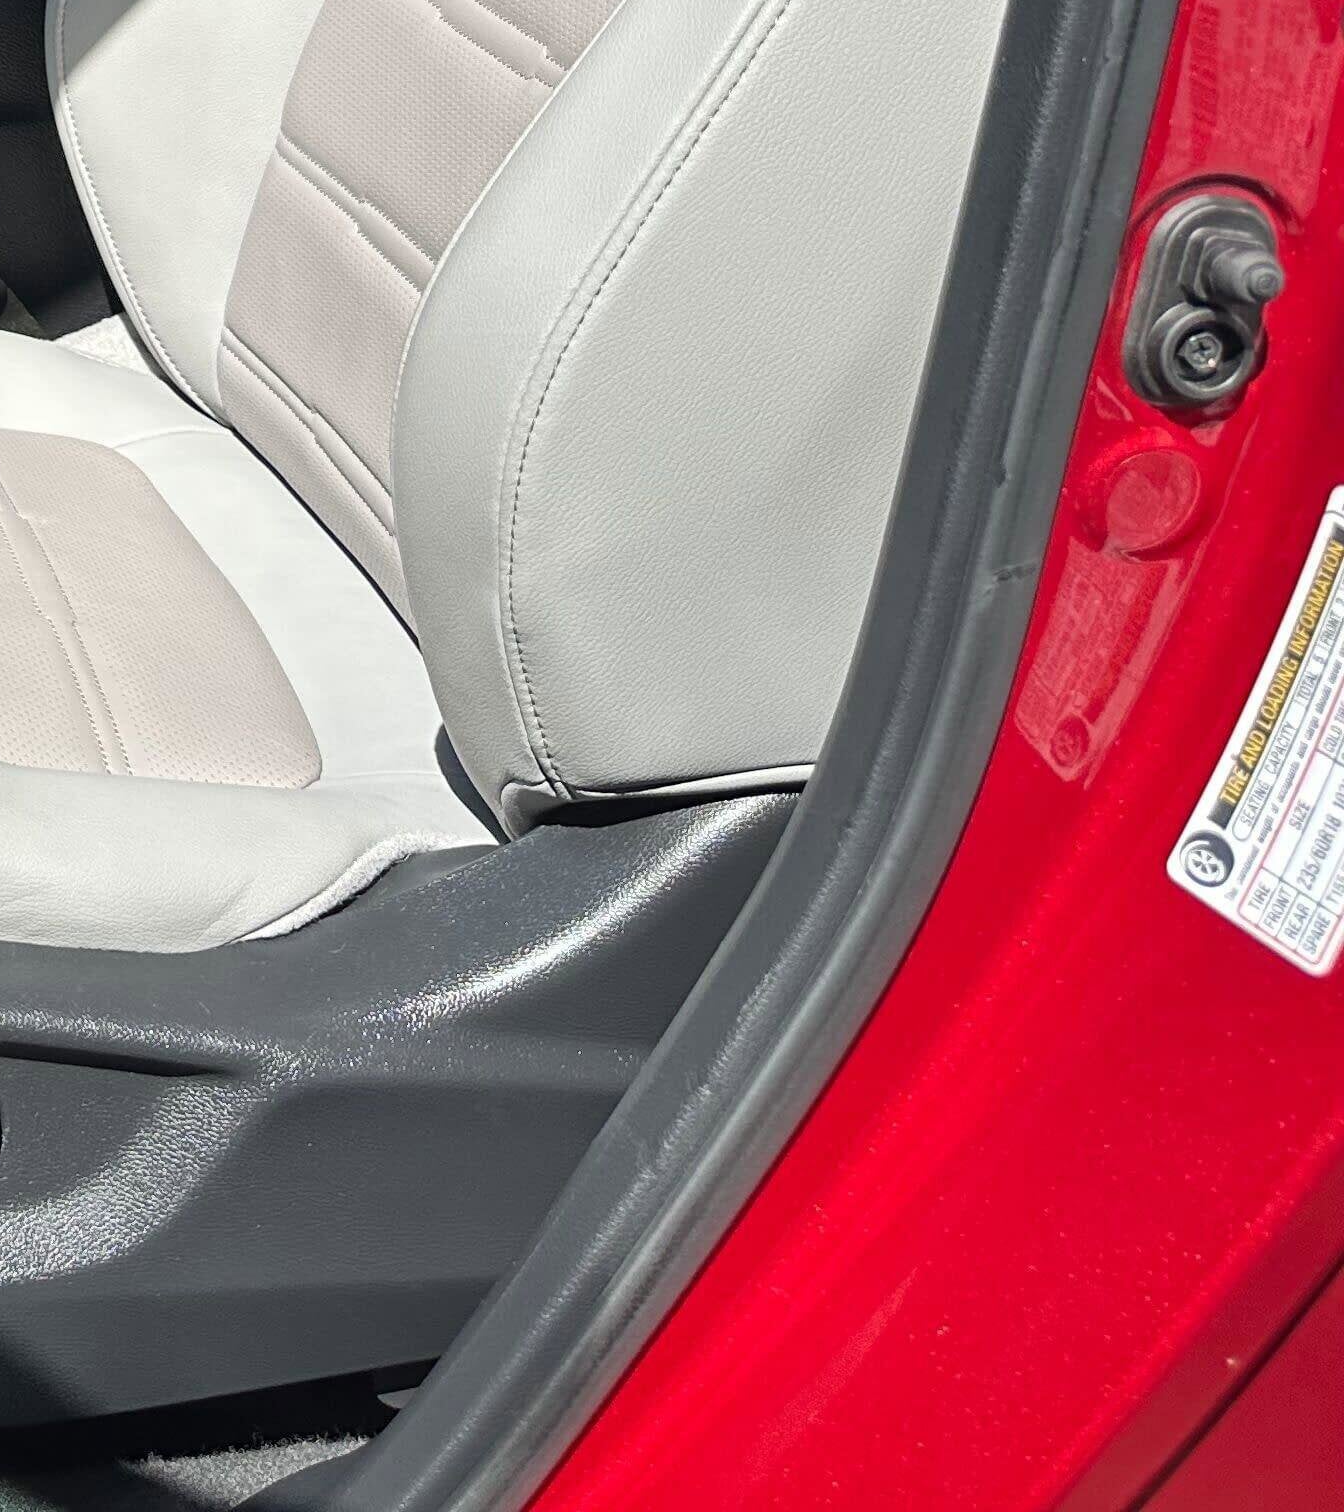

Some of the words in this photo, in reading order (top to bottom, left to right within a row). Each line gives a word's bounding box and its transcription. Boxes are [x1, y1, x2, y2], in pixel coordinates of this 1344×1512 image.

[1320, 613, 1341, 645] FRONT
[1221, 769, 1249, 805] TIRE
[1239, 731, 1263, 768] AND
[1257, 657, 1298, 727] LOADING
[1289, 541, 1344, 656] INFORMATION
[1297, 670, 1318, 702] TOTAL
[1322, 722, 1342, 755] COLD
[1243, 782, 1269, 828] SEATING
[1265, 721, 1296, 774] CAPACITY
[1289, 798, 1310, 831] SIZE
[1297, 814, 1342, 891] 235/60R18
[1248, 883, 1271, 911] TIRE
[1263, 886, 1293, 930] FRONT
[1285, 903, 1310, 941] REAR
[1302, 910, 1331, 956] SPARE
